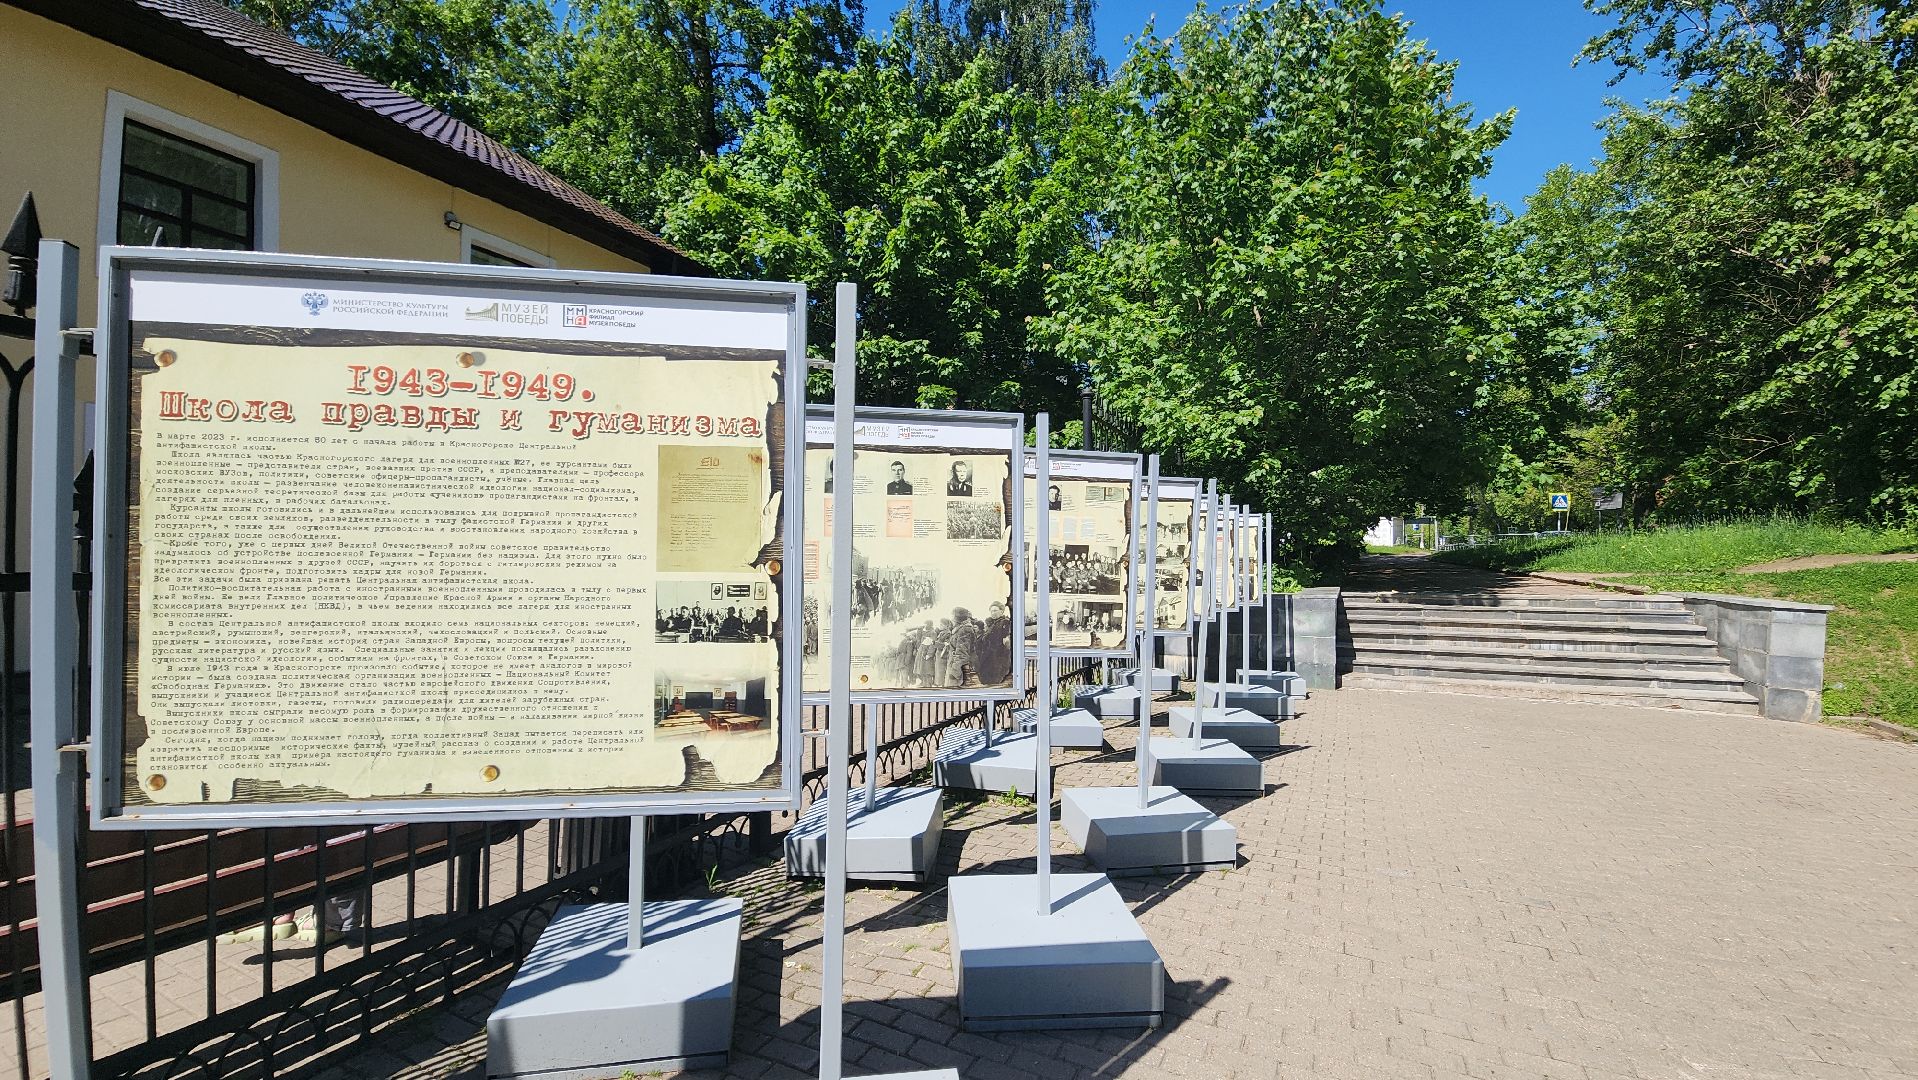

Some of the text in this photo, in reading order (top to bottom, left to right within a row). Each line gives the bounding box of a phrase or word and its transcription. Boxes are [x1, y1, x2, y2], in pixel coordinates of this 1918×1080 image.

[333, 299, 449, 310] МИНИСТЕРСТВО КУЛЬТУРЫ
[501, 303, 549, 315] МУЗЕЙ
[332, 306, 449, 318] РОССИЙСКОЙ ФЕДЕРАЦИИ
[588, 308, 644, 317] КРАСНОГОРСКИЙ
[501, 313, 548, 326] ПОБЕДЫ
[158, 390, 763, 439] Школа правды и гуманизма
